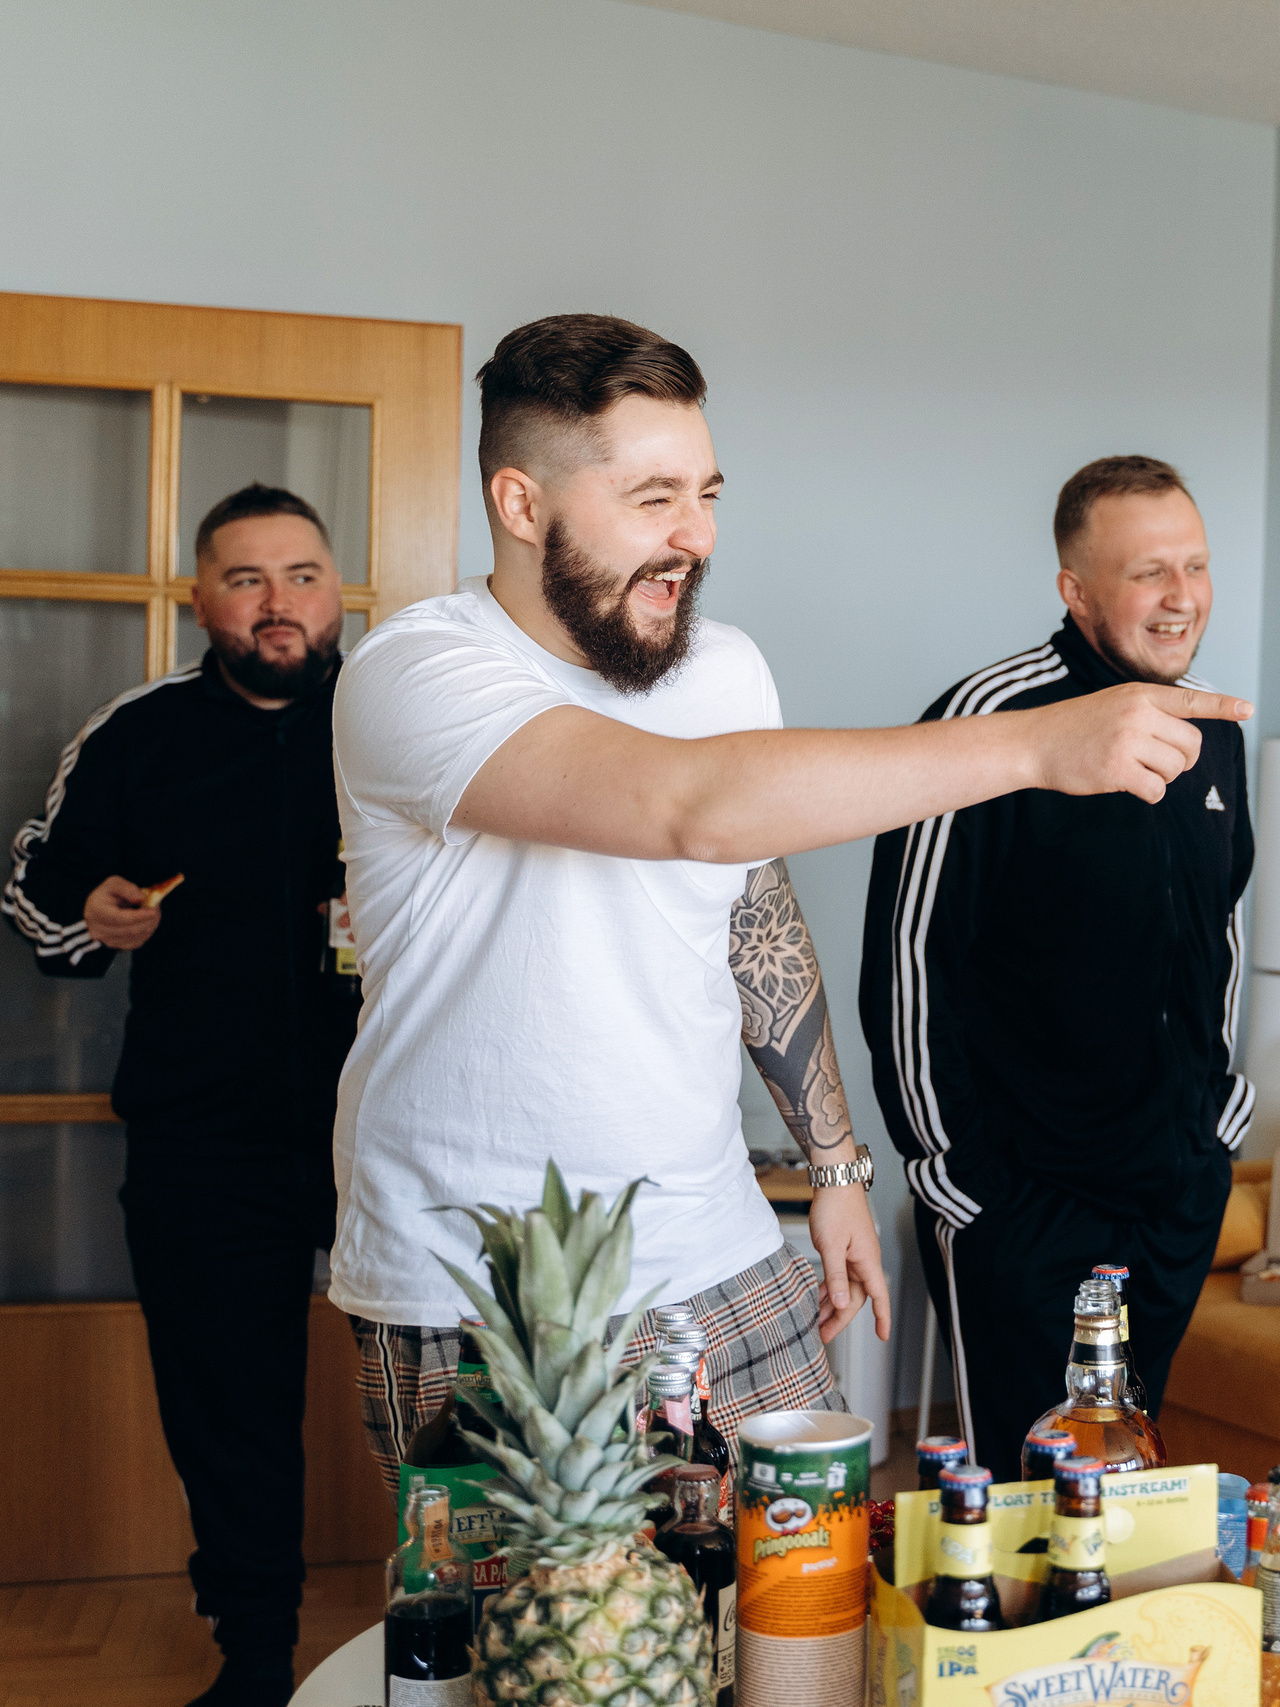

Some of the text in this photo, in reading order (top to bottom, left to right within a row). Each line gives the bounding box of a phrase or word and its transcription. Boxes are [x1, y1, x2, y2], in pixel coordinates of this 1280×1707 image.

[990, 1493, 1034, 1507] LOAT
[1102, 1478, 1187, 1497] INSTREAM!
[938, 1661, 979, 1677] IPA
